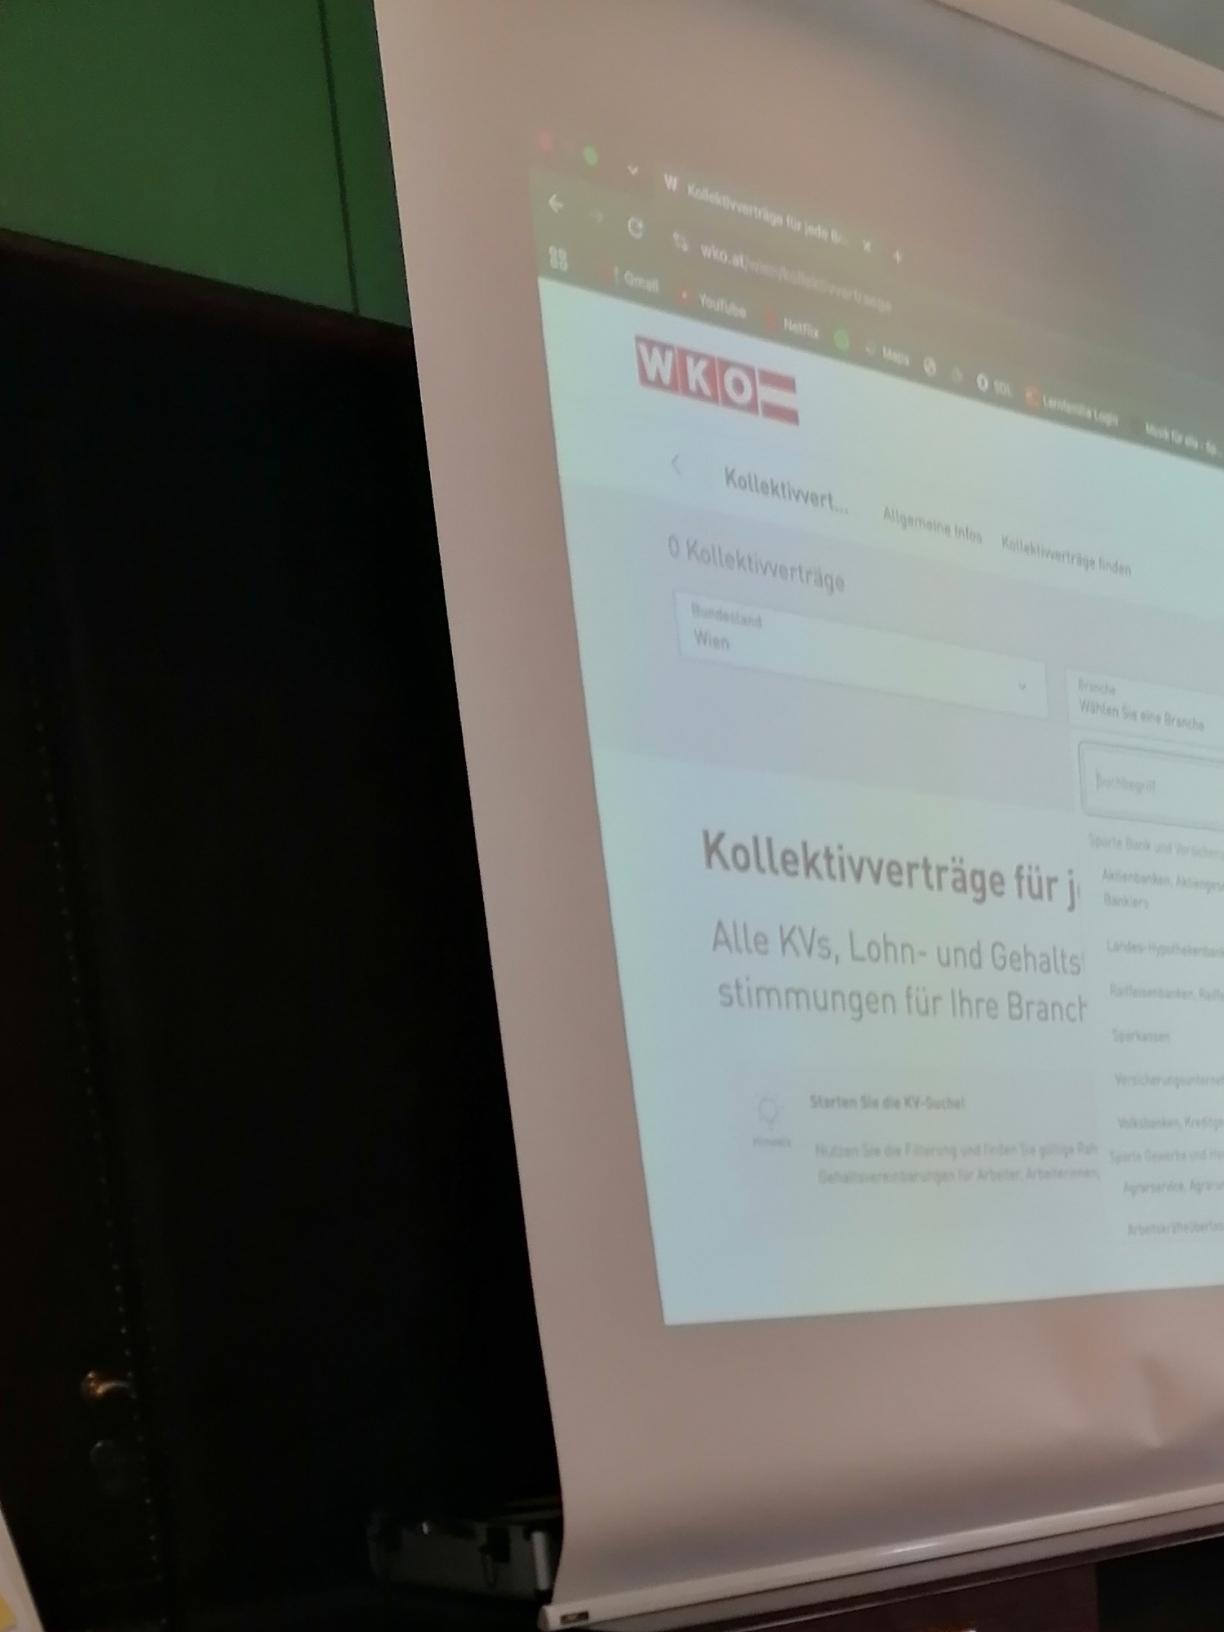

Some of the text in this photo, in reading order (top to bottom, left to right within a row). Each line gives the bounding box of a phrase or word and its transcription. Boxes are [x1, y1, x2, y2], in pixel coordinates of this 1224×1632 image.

[687, 184, 783, 227] Kollektivverträge
[786, 214, 801, 232] für
[624, 269, 659, 293] Gmail
[700, 293, 747, 319] YouTube
[784, 317, 819, 339] Netflix
[637, 341, 753, 405] WKO
[724, 465, 1132, 577] Kollektivvert... Allgemeine Infos Kollektivverträge finden
[668, 533, 846, 597] 0 Kollektivverträge
[694, 628, 730, 651] Wien
[1078, 677, 1116, 696] Branche
[1079, 697, 1205, 732] Wählen Sie eine Branche
[702, 829, 1006, 905] Kollektivverträge
[1014, 863, 1058, 901] für
[1089, 832, 1122, 850] Sparte
[1125, 834, 1150, 851] Bank
[1153, 841, 1173, 855] und
[1103, 892, 1149, 910] Bankiers
[712, 919, 770, 957] Alle
[779, 923, 841, 966] KVs,
[848, 928, 928, 967] Lohn-
[936, 940, 983, 971] und
[717, 975, 898, 1022] stimmungen
[905, 985, 943, 1018] für
[951, 986, 999, 1021] Ihre
[810, 1093, 858, 1110] Starten
[860, 1094, 880, 1110] Sie
[882, 1095, 900, 1110] die
